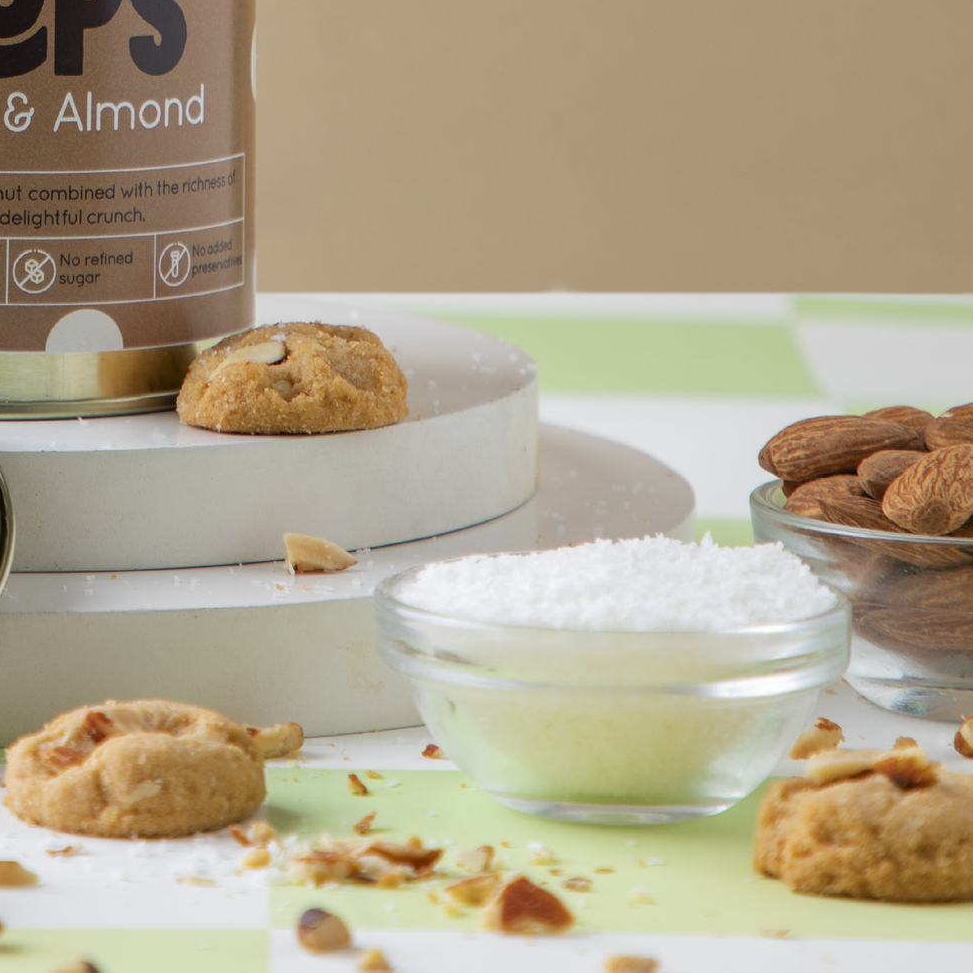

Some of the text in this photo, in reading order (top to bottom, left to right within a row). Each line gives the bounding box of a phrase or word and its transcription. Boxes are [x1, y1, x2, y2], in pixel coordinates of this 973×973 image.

[3, 92, 34, 132] &
[53, 84, 205, 132] Almond
[28, 184, 115, 201] combined
[121, 182, 152, 199] with
[157, 180, 179, 196] the
[182, 176, 226, 194] richness
[227, 169, 236, 186] of
[0, 209, 82, 229] delightful
[87, 207, 146, 224] crunch.
[60, 251, 133, 267] No refined
[192, 238, 233, 258] No added
[191, 254, 243, 278] preservatives
[59, 273, 100, 287] sugar
